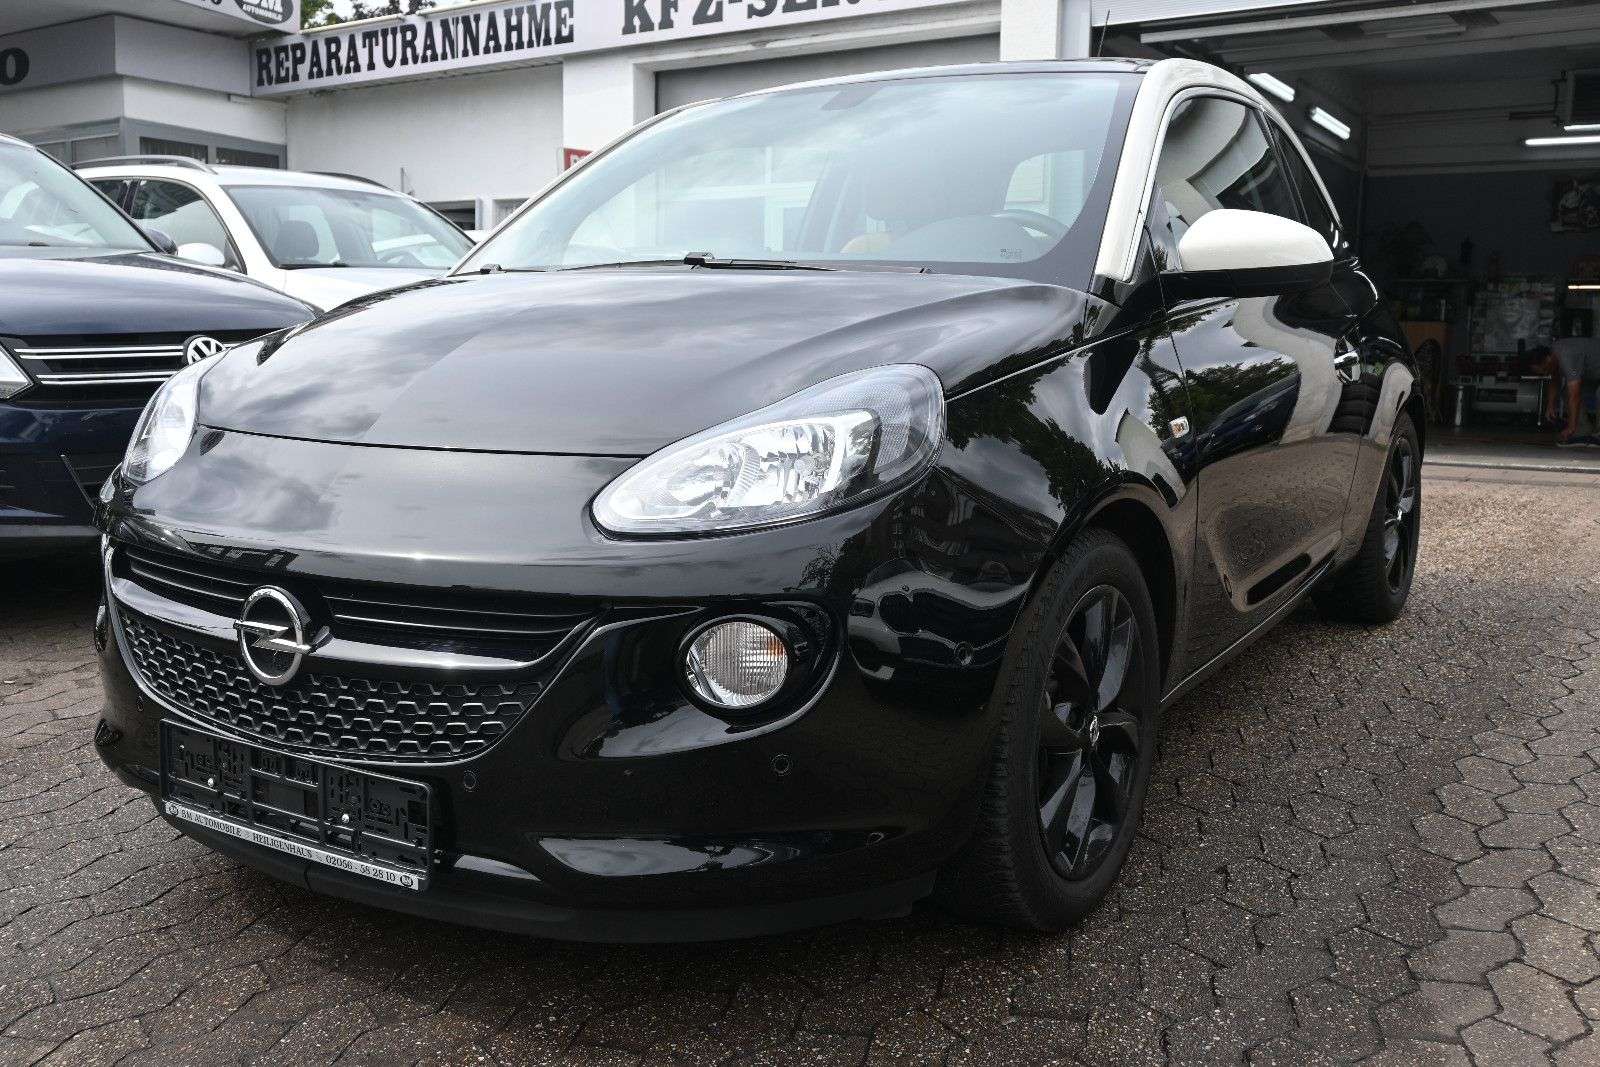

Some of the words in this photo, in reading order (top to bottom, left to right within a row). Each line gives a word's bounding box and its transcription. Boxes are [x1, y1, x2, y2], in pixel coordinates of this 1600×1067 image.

[256, 3, 574, 87] REPARATURANNAHME
[194, 814, 242, 837] AUTOMOBILE
[252, 832, 313, 859] HEILIGENHAUS
[325, 855, 353, 870] 02056
[385, 871, 396, 882] 10
